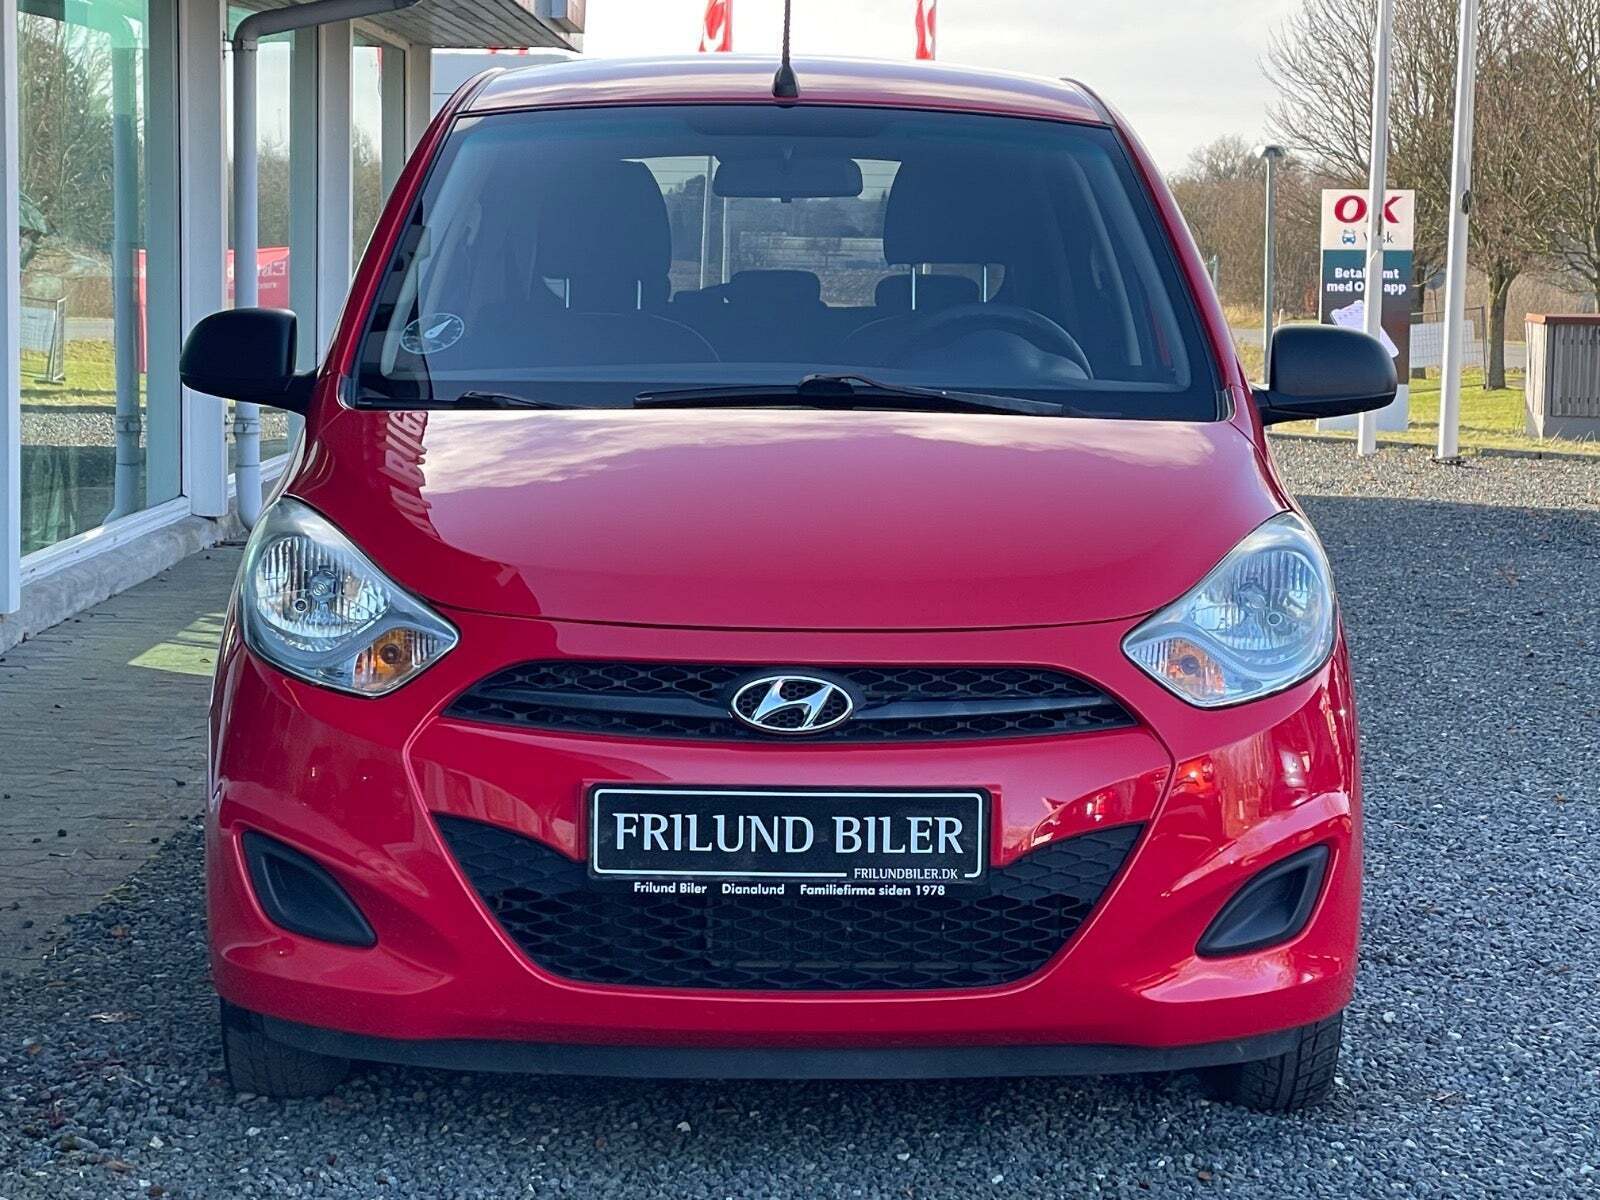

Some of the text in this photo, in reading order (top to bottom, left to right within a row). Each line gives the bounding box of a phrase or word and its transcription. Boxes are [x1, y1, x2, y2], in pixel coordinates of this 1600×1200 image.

[1335, 267, 1366, 279] Betal
[1326, 281, 1352, 292] med
[612, 813, 964, 854] FRILUND BILER
[854, 868, 958, 880] FRILUNDBILER.DK
[634, 881, 946, 896] Frilund Biler Dianalund Familiefirma siden 1978
